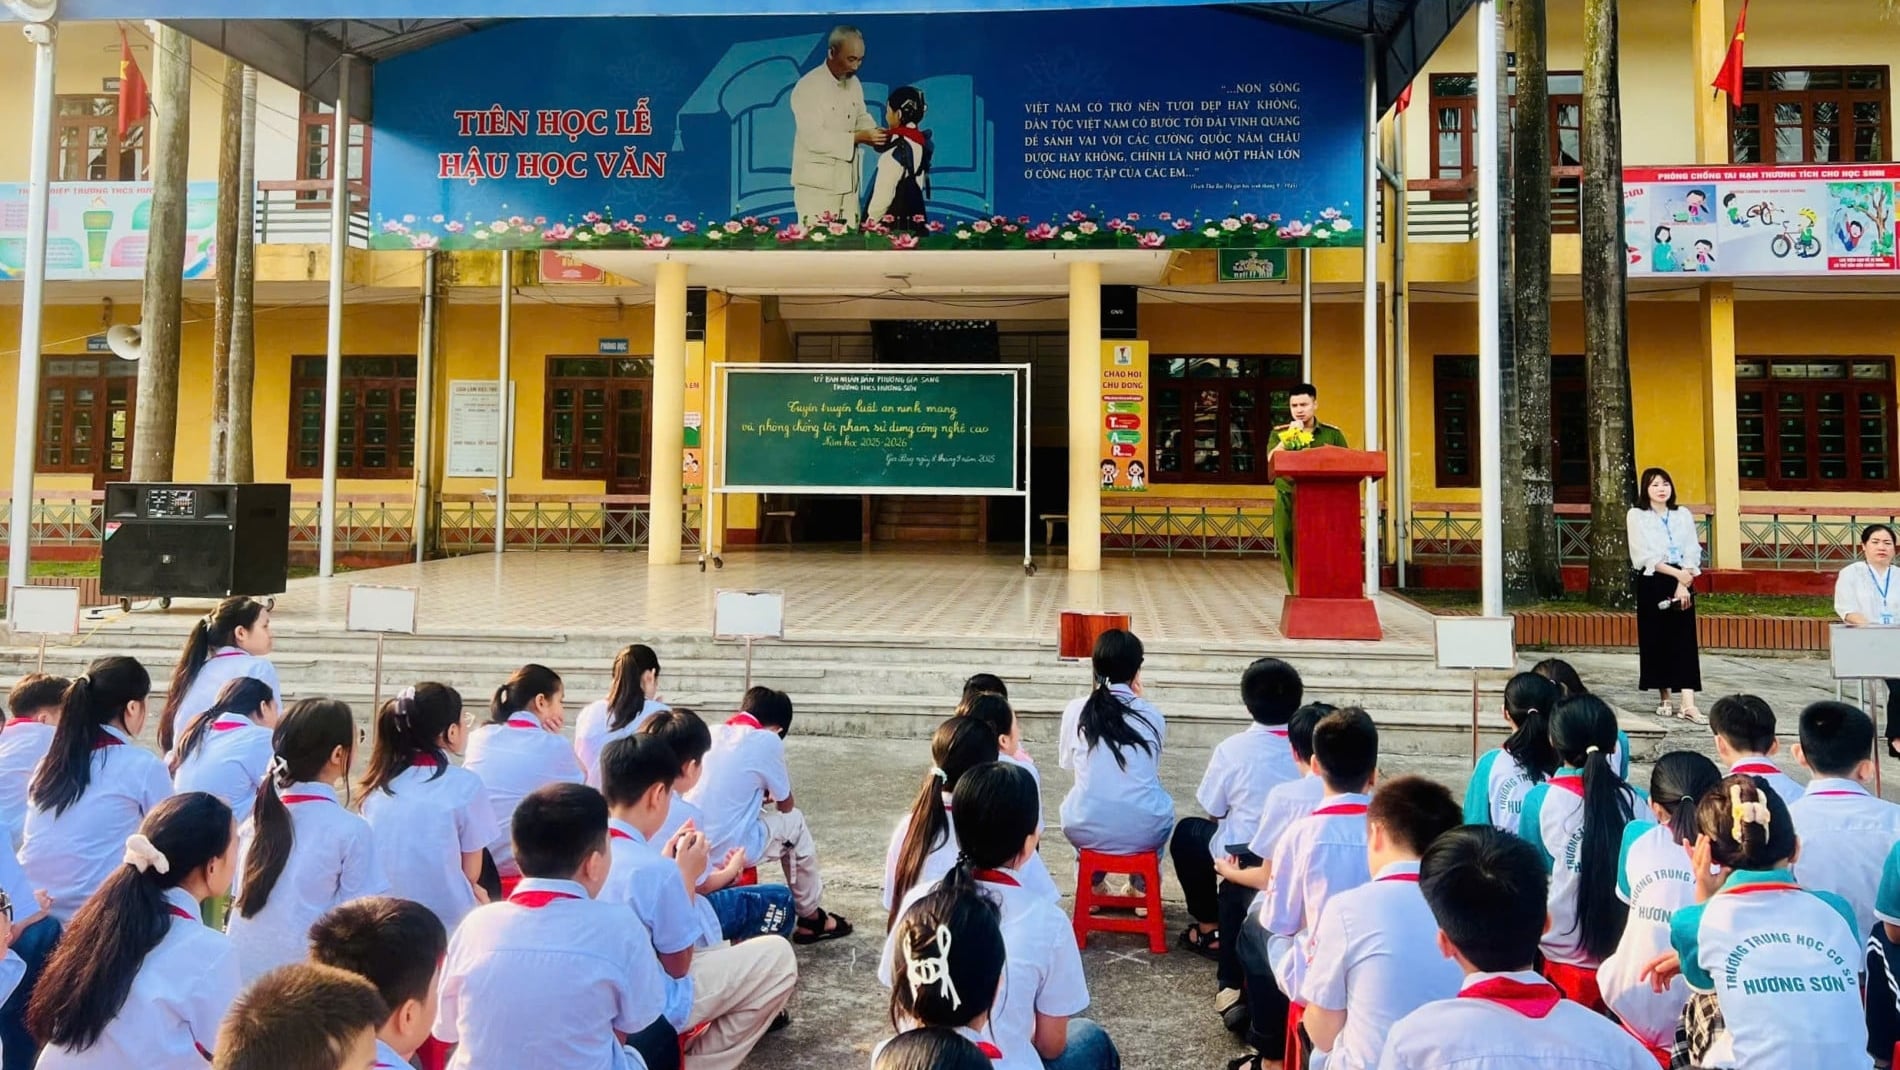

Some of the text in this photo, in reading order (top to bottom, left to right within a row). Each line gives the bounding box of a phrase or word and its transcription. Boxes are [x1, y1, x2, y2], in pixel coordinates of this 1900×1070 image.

[1024, 101, 1050, 115] VIỆT
[1055, 103, 1081, 113] NAM
[1228, 100, 1250, 111] HAY
[454, 97, 652, 143] TIÊN HỌC LỄ
[1077, 116, 1101, 131] VIỆT
[1104, 119, 1129, 128] NAM
[1229, 117, 1258, 127] VINH
[1261, 116, 1300, 127] QUANG
[1079, 136, 1097, 145] VAI
[1060, 152, 1082, 162] HAY
[437, 145, 667, 186] HẬU HỌC VĂN
[1069, 168, 1093, 181] HỌC
[1690, 169, 1721, 180] CHỐNG
[1724, 171, 1737, 179] TAI
[1799, 169, 1819, 178] TÍCH
[1821, 170, 1840, 178] CHO
[881, 404, 894, 413] an
[1654, 868, 1691, 882] TRUNG
[1638, 906, 1672, 924] HƯƠN
[1744, 932, 1791, 949] TRUNG
[1796, 934, 1825, 952] HỌC
[1743, 974, 1847, 995] HƯƠNG SƠN
